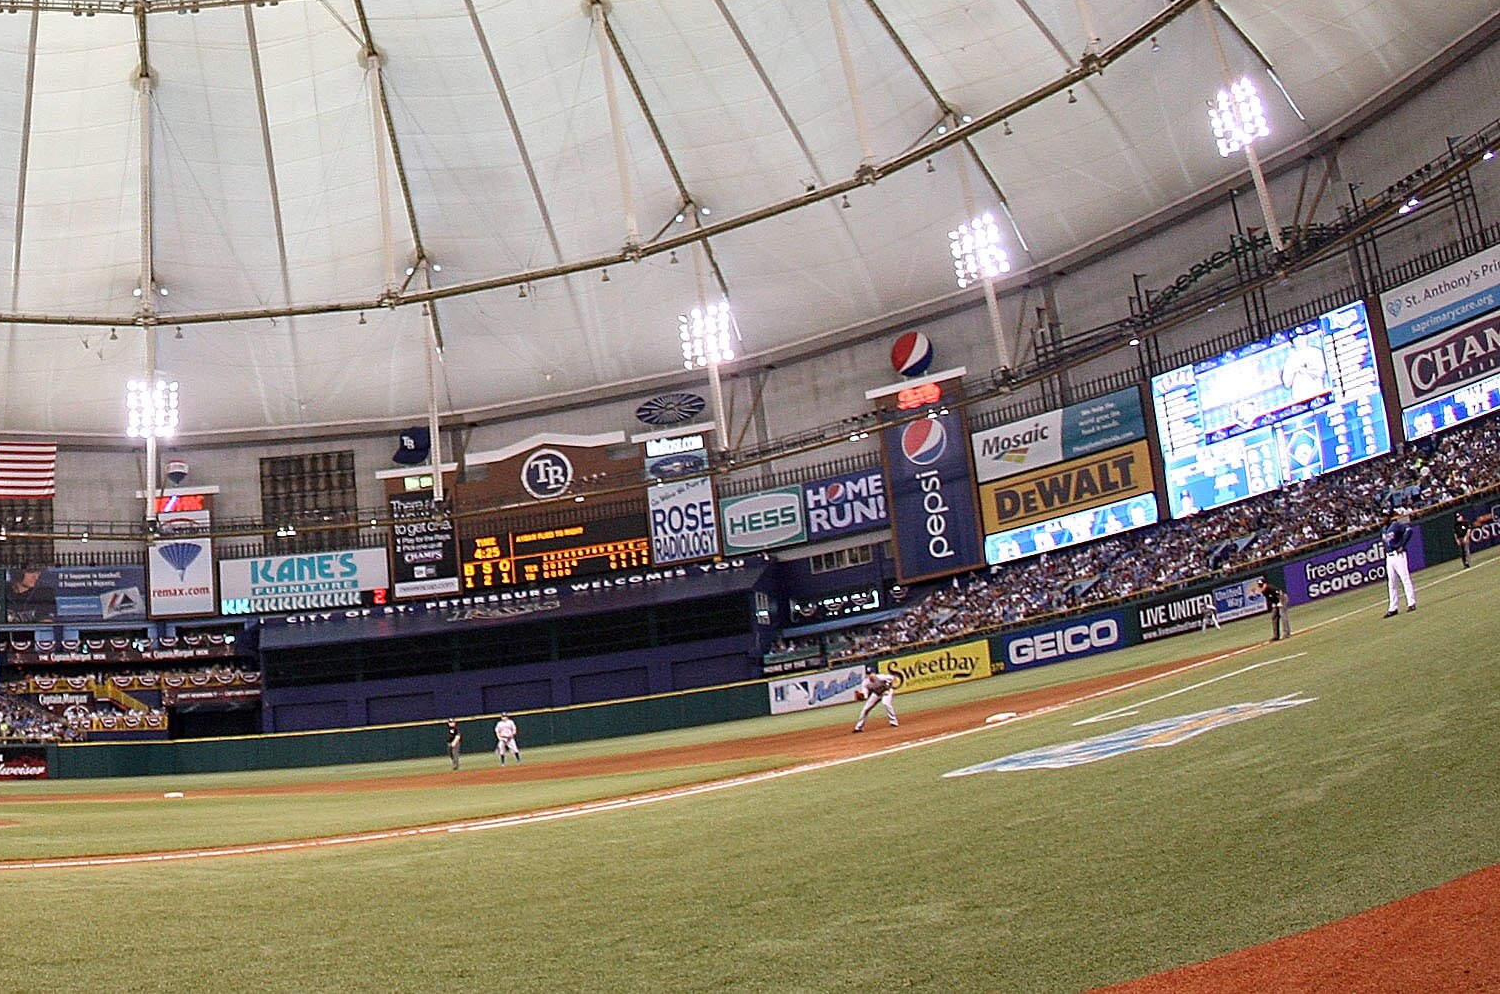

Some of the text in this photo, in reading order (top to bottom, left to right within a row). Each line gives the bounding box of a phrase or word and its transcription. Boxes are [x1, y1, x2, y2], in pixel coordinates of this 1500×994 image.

[1405, 295, 1421, 308] St.
[1423, 269, 1480, 300] Anthony's
[1411, 293, 1495, 333] saprimarycare.org
[401, 436, 415, 450] TB
[981, 423, 1049, 457] Mosaic
[530, 459, 565, 490] TB
[394, 522, 427, 537] to get
[651, 501, 715, 538] ROSE
[728, 505, 796, 536] HESS
[809, 495, 888, 533] RUN!
[915, 469, 955, 558] pepsi
[404, 549, 443, 563] CHAMPS
[473, 546, 501, 560] 4:25
[654, 529, 716, 562] RADIOLOGY
[1306, 541, 1386, 581] freecredi
[251, 552, 358, 584] KANE'S
[463, 559, 511, 577] B S O
[465, 577, 475, 588] 1
[483, 575, 493, 586] 2
[501, 573, 511, 584] 1
[1308, 565, 1386, 598] score.co
[152, 585, 210, 598] remax.com
[254, 580, 352, 596] FURNITURE
[286, 612, 332, 624] CITY
[345, 609, 372, 618] OF
[383, 604, 414, 614] ST.
[425, 587, 558, 609] PETERSBURG
[570, 568, 687, 592] WELCOMES
[699, 559, 745, 573] YOU
[372, 588, 387, 604] 2
[1139, 605, 1167, 628] LIVE
[1168, 593, 1213, 621] UNITED
[1007, 618, 1119, 665] GEICO
[887, 651, 980, 689] Sweetbay
[38, 694, 88, 705] Captain Morgan
